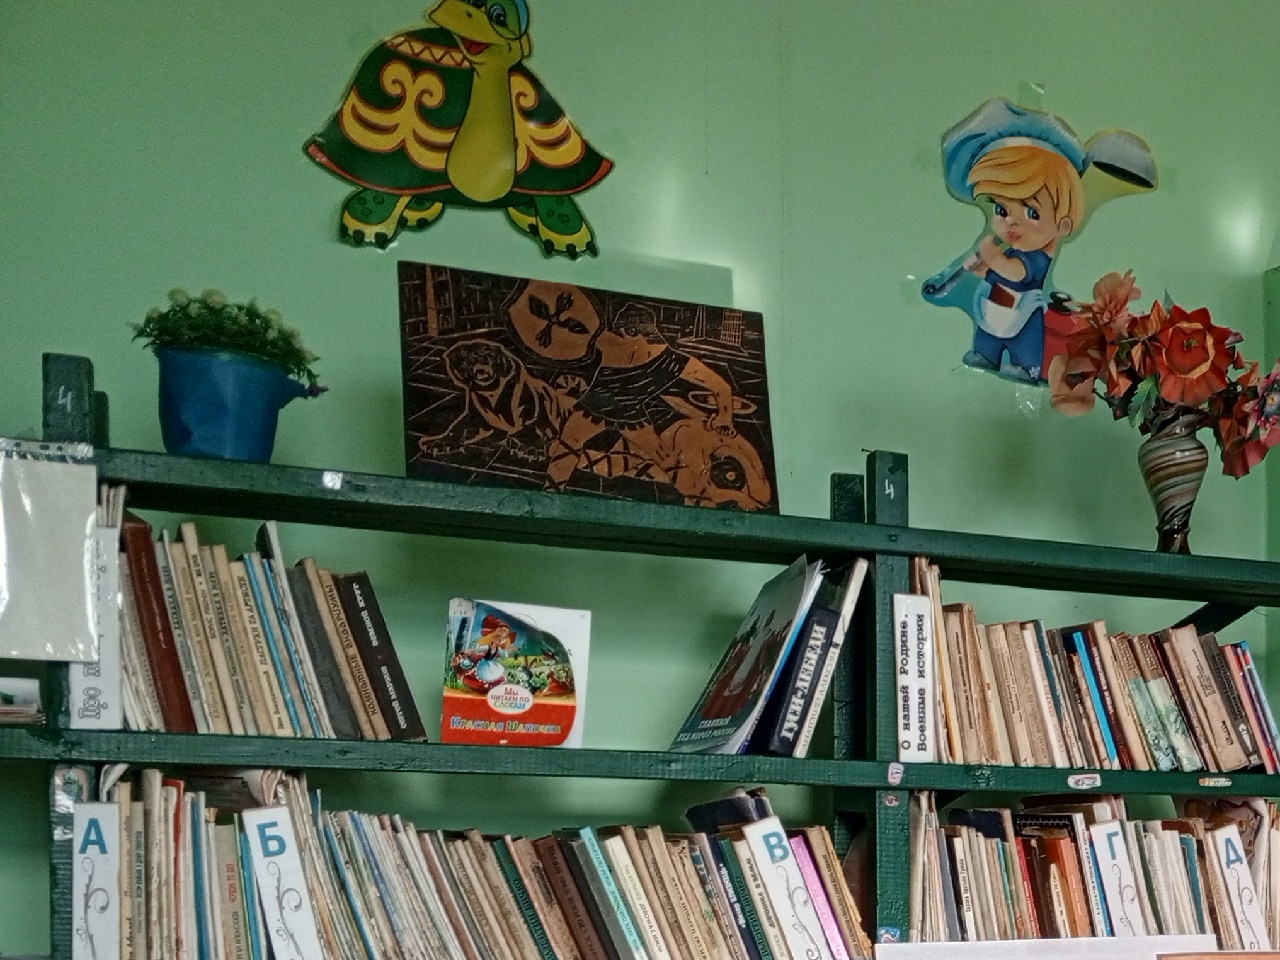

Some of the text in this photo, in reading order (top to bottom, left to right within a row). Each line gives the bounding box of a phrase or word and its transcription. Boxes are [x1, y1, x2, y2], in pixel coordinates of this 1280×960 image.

[57, 385, 72, 413] 4
[884, 479, 894, 499] 4
[900, 614, 911, 750] О нашей Родине.
[917, 614, 927, 751] Военные истории
[78, 818, 108, 854] А
[256, 821, 287, 858] Б
[762, 831, 790, 864] В
[1106, 831, 1120, 860] Г
[1224, 837, 1243, 869] Д
